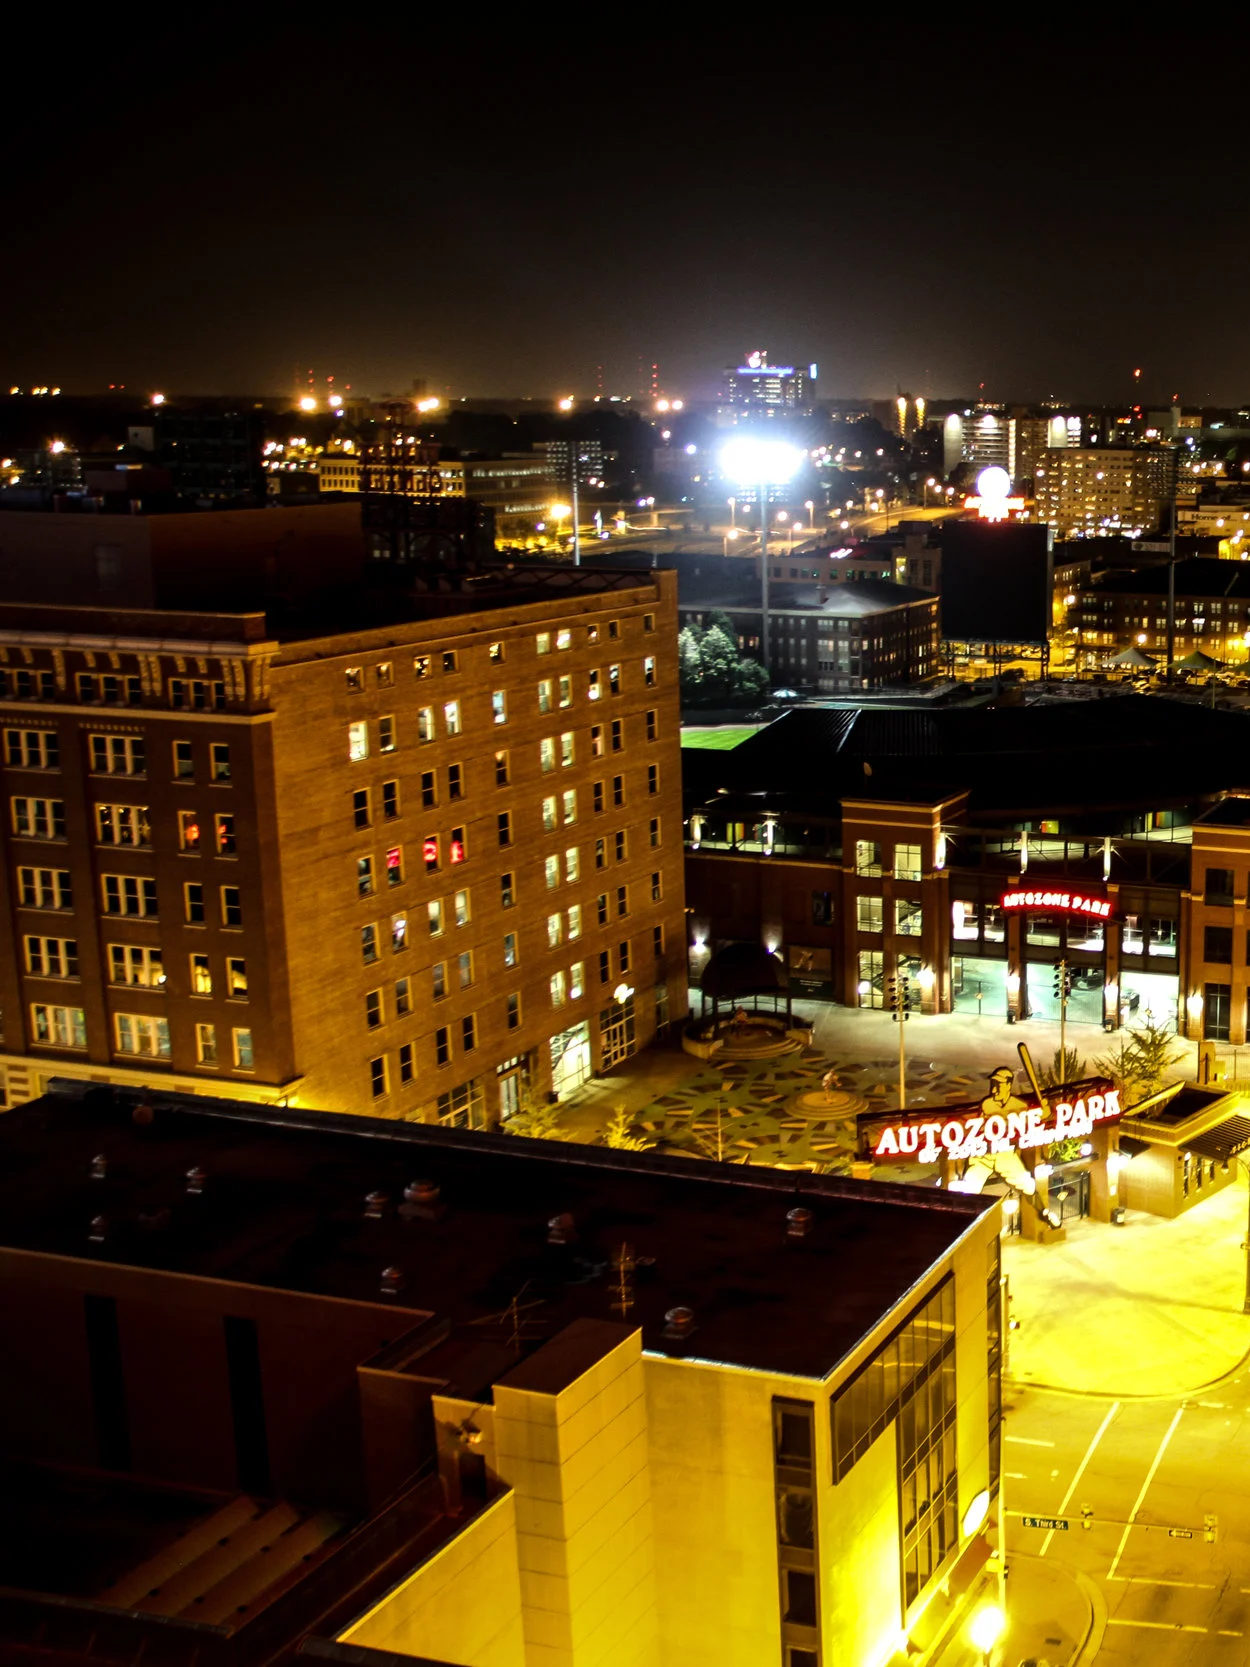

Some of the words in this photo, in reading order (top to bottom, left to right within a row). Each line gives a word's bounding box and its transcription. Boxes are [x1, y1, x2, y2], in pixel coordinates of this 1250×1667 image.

[1072, 896, 1111, 916] PARK
[875, 1108, 1043, 1155] AUTOZONE
[1055, 1090, 1120, 1127] PARK
